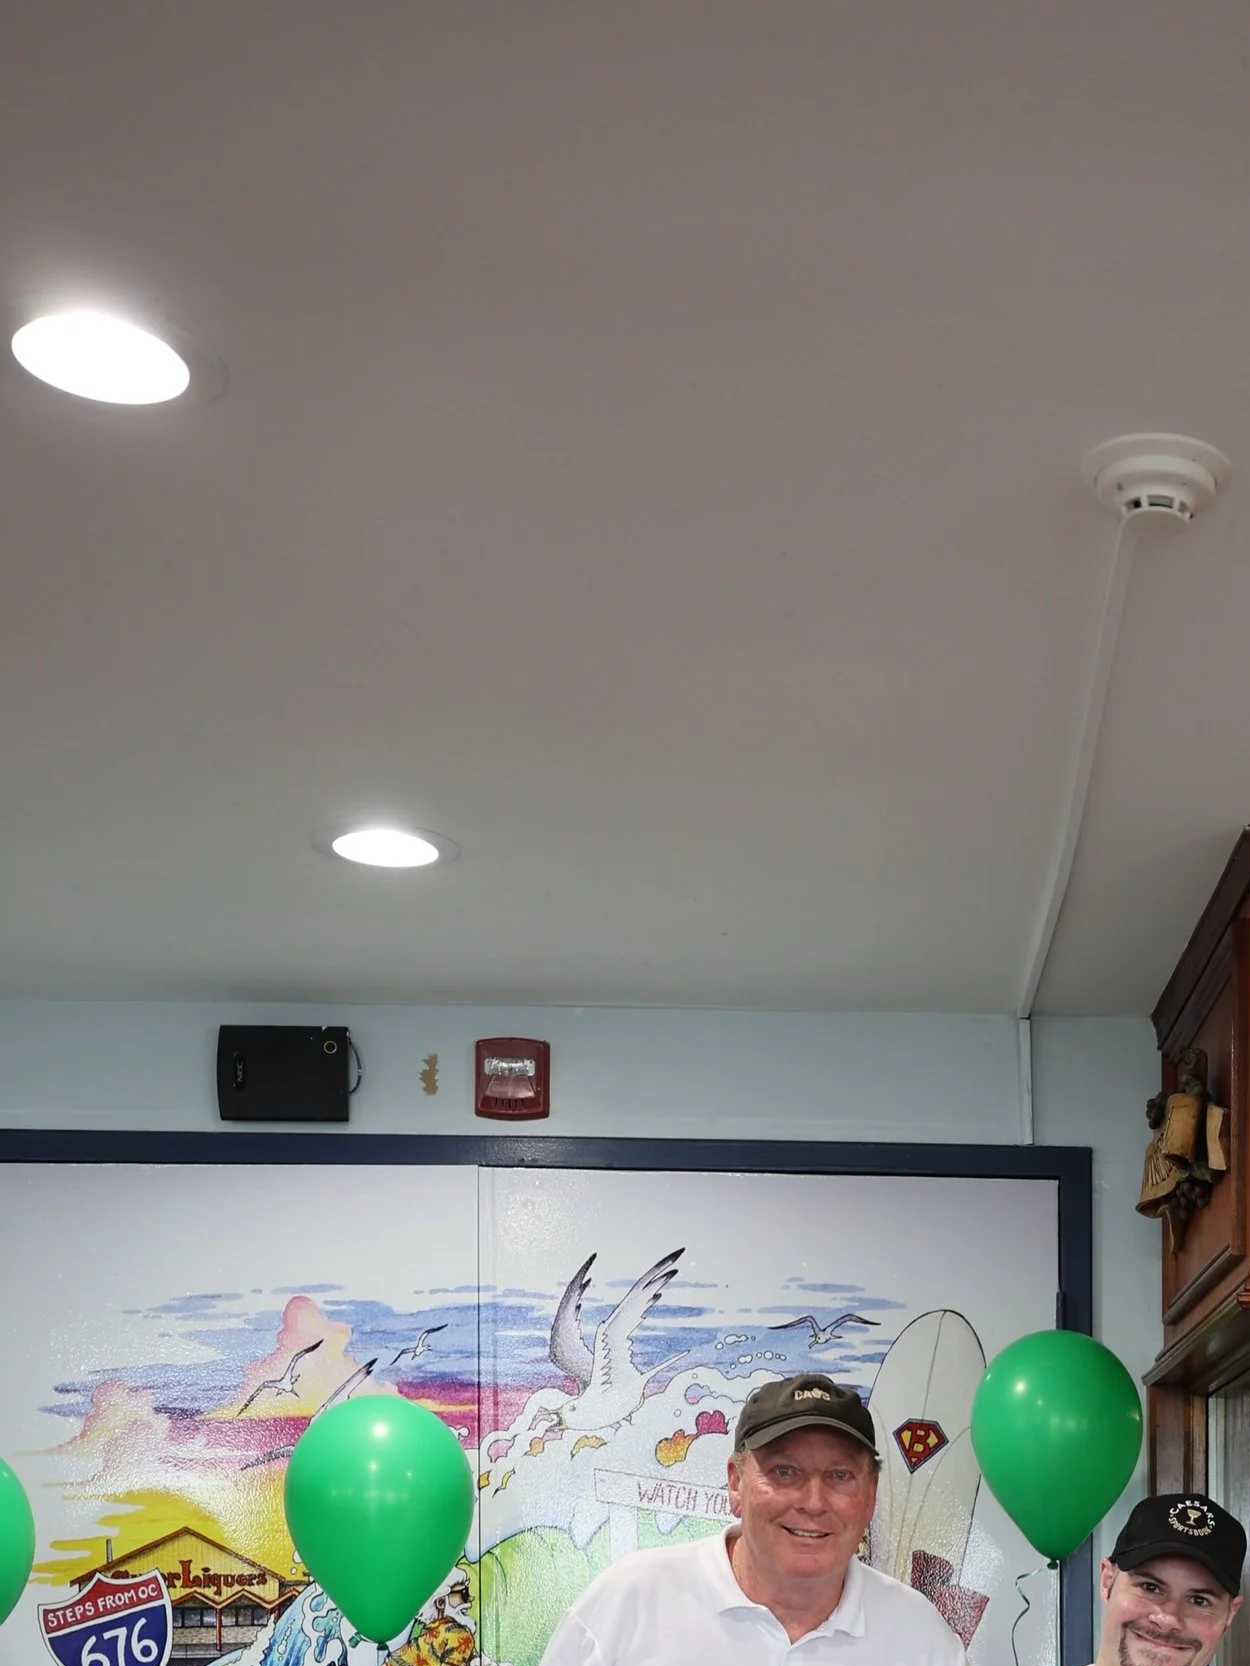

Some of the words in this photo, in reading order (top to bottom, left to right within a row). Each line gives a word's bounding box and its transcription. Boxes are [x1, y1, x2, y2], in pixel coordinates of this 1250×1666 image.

[637, 1482, 698, 1512] WATCH
[704, 1491, 733, 1516] YOU
[1169, 1500, 1216, 1527] CAESARS
[1168, 1516, 1212, 1537] SPORTSBOOK
[178, 1559, 268, 1597] Liquors
[47, 1601, 96, 1628] STEPS
[98, 1590, 136, 1612] FROM
[138, 1584, 159, 1600] OC
